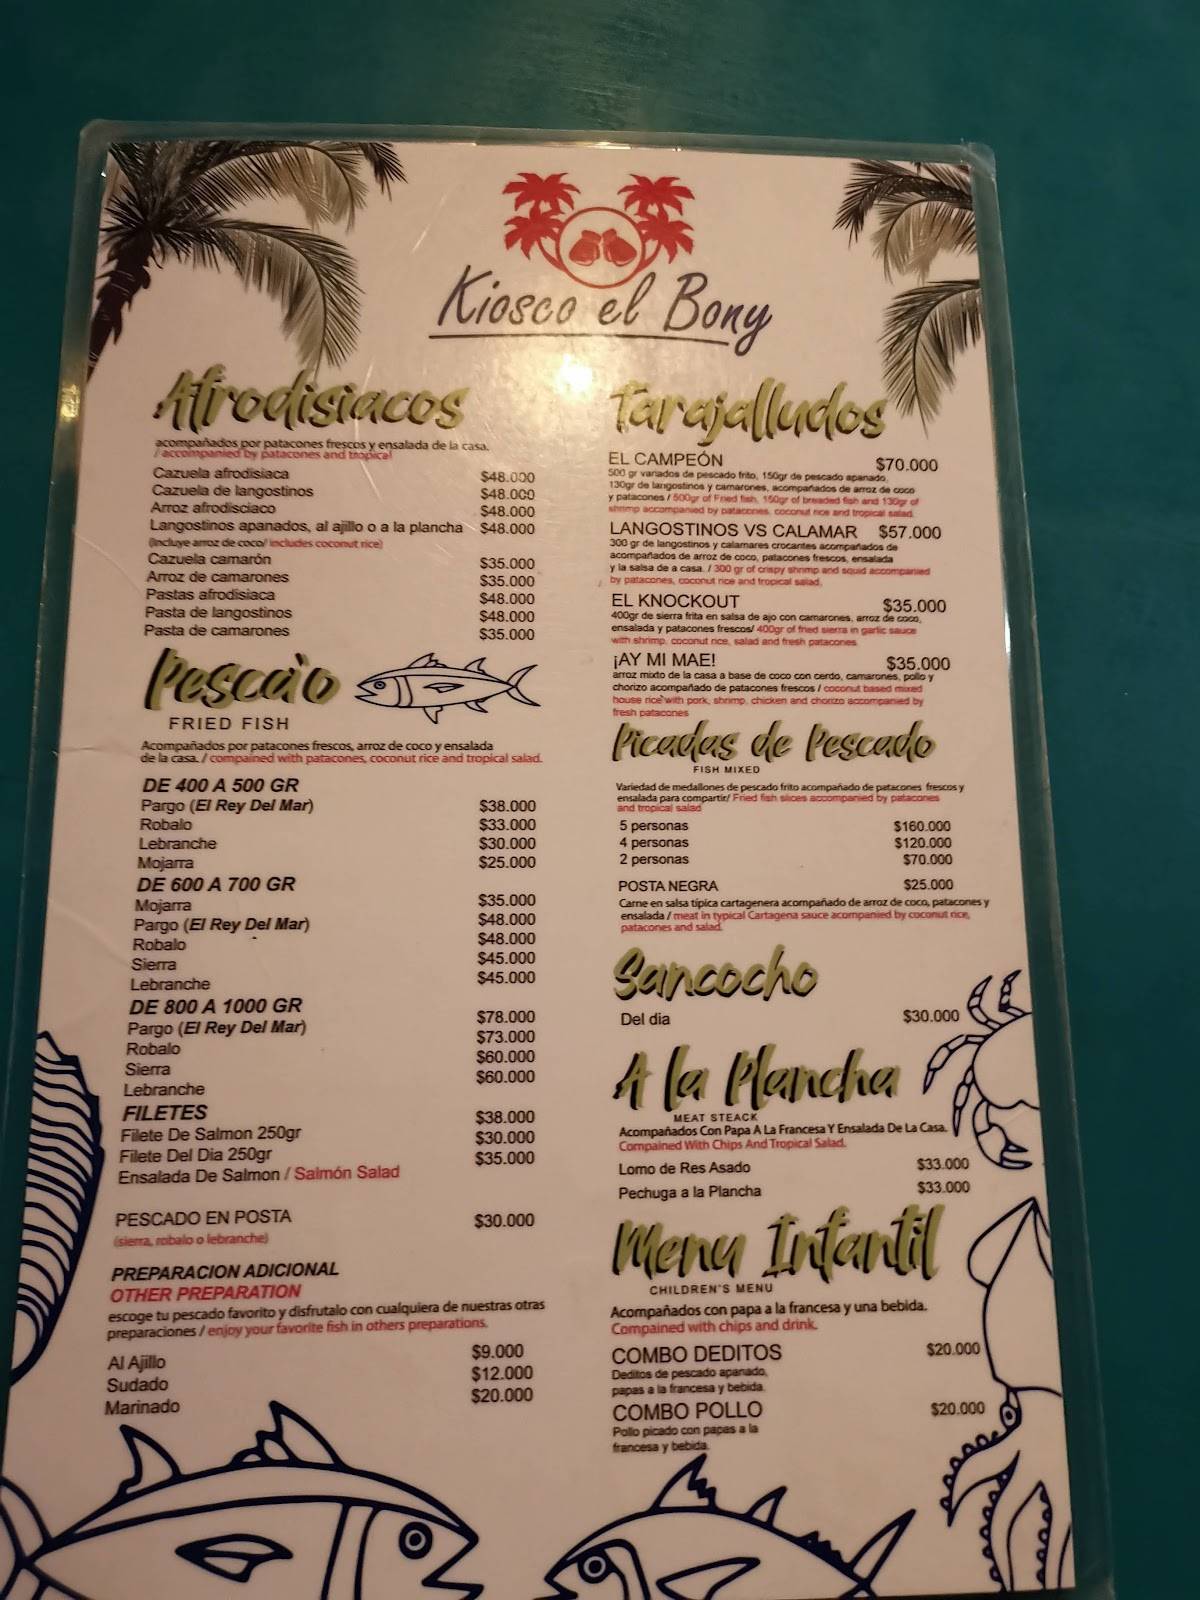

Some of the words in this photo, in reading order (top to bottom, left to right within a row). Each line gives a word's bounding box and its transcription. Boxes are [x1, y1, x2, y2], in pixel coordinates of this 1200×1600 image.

[437, 265, 577, 326] Kiosco
[598, 271, 657, 326] el
[663, 271, 774, 357] Bony
[152, 363, 471, 435] Afrodisiacos
[608, 451, 630, 467] EL
[634, 450, 723, 467] CAMPEÓN
[875, 457, 939, 473] $70.000
[152, 466, 211, 480] Cazuela
[213, 466, 290, 480] afrodisiaca
[150, 501, 189, 514] Arroz
[480, 505, 536, 519] $48.000
[149, 518, 236, 535] Langostinos
[237, 519, 312, 535] apanados,
[315, 520, 329, 532] al
[331, 519, 364, 536] ajillo
[366, 523, 377, 533] o
[380, 523, 390, 533] a
[393, 521, 406, 534] la
[409, 521, 464, 536] plancha
[479, 522, 536, 536] $48.000
[610, 521, 739, 537] LANGOSTINOS
[743, 523, 768, 538] VS
[772, 524, 858, 539] CALAMAR
[878, 524, 942, 541] $57.000
[146, 570, 186, 583] Arroz
[188, 570, 208, 583] de
[210, 573, 290, 583] camarones
[479, 574, 536, 588] $35.000
[145, 587, 195, 601] Pastas
[198, 588, 276, 601] afrodisiaca
[479, 592, 536, 606] $48.000
[612, 593, 634, 608] EL
[638, 593, 741, 609] KNOCKOUT
[882, 598, 947, 614] $35.000
[613, 652, 642, 670] ¡AY
[646, 652, 666, 667] MI
[672, 652, 716, 671] MAE!
[886, 656, 951, 672] $35.000
[168, 716, 232, 731] FRIED
[241, 716, 289, 731] FISH
[140, 740, 226, 755] Acompañados
[227, 742, 249, 753] por
[250, 741, 311, 755] patacones
[311, 740, 355, 754] frescos,
[356, 742, 387, 751] arroz
[387, 740, 404, 751] de
[405, 742, 433, 752] coco
[434, 743, 443, 754] y
[443, 740, 494, 752] ensalada
[611, 719, 740, 763] Picadas
[750, 719, 793, 763] de
[804, 719, 938, 763] Pescado
[692, 765, 720, 774] FISH
[724, 765, 761, 774] MIXED
[142, 777, 172, 793] DE
[174, 777, 210, 793] 400
[211, 777, 227, 793] A
[231, 778, 265, 793] 500
[270, 777, 300, 793] GR
[141, 798, 186, 815] Pargo
[189, 798, 213, 815] (El
[215, 798, 247, 815] Rey
[249, 798, 277, 812] Del
[278, 798, 314, 815] Mar)
[479, 799, 537, 814] $38.000
[139, 817, 193, 831] Robalo
[479, 817, 537, 833] $33.000
[619, 819, 628, 831] 5
[630, 822, 689, 834] personas
[893, 820, 952, 833] $160.000
[138, 837, 218, 850] Lebranche
[478, 836, 537, 851] $30.000
[137, 856, 195, 872] Mojarra
[478, 855, 537, 870] $25.000
[619, 853, 628, 865] 2
[631, 855, 690, 868] personas
[903, 853, 953, 866] $70.000
[618, 880, 666, 892] POSTA
[668, 879, 719, 892] NEGRA
[903, 878, 954, 892] $25.000
[130, 957, 177, 972] Sierra
[477, 951, 536, 966] $45.000
[612, 943, 819, 1002] Sancocho
[128, 999, 160, 1016] DE
[163, 998, 199, 1015] 800
[200, 998, 216, 1015] A
[223, 998, 268, 1014] 1000
[272, 997, 303, 1014] GR
[476, 1009, 536, 1025] $78.000
[620, 1012, 645, 1026] Del
[648, 1012, 671, 1026] dia
[902, 1008, 960, 1024] $30.000
[476, 1029, 536, 1045] $73.000
[612, 1050, 652, 1111] A
[664, 1043, 710, 1113] la
[724, 1043, 902, 1111] Plancha
[121, 1104, 209, 1122] FILETES
[475, 1110, 536, 1126] $38.000
[673, 1113, 705, 1123] MEAT
[710, 1112, 758, 1123] STEACK
[120, 1128, 164, 1142] Filete
[167, 1127, 191, 1141] De
[194, 1126, 253, 1141] Salmon
[256, 1125, 302, 1143] 250gr
[474, 1150, 535, 1167] $35.000
[916, 1157, 970, 1171] $33.000
[118, 1169, 191, 1185] Ensalada
[195, 1168, 218, 1183] De
[221, 1167, 281, 1182] Salmon
[294, 1165, 352, 1181] Salmón
[356, 1164, 400, 1180] Salad
[618, 1162, 657, 1176] Lomo
[659, 1162, 677, 1175] de
[679, 1161, 707, 1175] Res
[708, 1161, 751, 1174] Asado
[618, 1186, 678, 1203] Pechuga
[680, 1188, 690, 1199] a
[692, 1185, 705, 1198] la
[708, 1184, 762, 1198] Plancha
[917, 1180, 971, 1195] $33.000
[115, 1211, 202, 1227] PESCADO
[205, 1210, 230, 1225] EN
[234, 1209, 293, 1224] POSTA
[474, 1213, 535, 1229] $30.000
[611, 1218, 747, 1280] Menu
[762, 1203, 946, 1284] Infantil
[111, 1265, 241, 1281] PREPARACION
[242, 1262, 340, 1278] ADICIONAL
[110, 1287, 173, 1303] OTHER
[176, 1284, 302, 1300] PREPARATION
[735, 1283, 773, 1294] MENU
[610, 1304, 702, 1321] Acompañados
[703, 1306, 728, 1316] con
[730, 1305, 763, 1319] papa
[764, 1305, 773, 1315] a
[775, 1302, 787, 1315] la
[788, 1301, 842, 1314] francesa
[843, 1303, 852, 1316] y
[853, 1303, 878, 1313] una
[880, 1300, 928, 1312] bebida.
[471, 1343, 525, 1361] $9.000
[611, 1346, 688, 1364] COMBO
[694, 1344, 783, 1362] DEDITOS
[926, 1340, 981, 1357] $20.000
[106, 1355, 125, 1370] Al
[127, 1354, 167, 1373] Ajillo
[471, 1365, 534, 1383] $12.000
[106, 1376, 169, 1393] Sudado
[471, 1387, 534, 1404] $20.000
[104, 1398, 181, 1415] Marinado
[612, 1402, 690, 1422] COMBO
[695, 1400, 764, 1419] POLLO
[930, 1401, 986, 1417] $20.000
